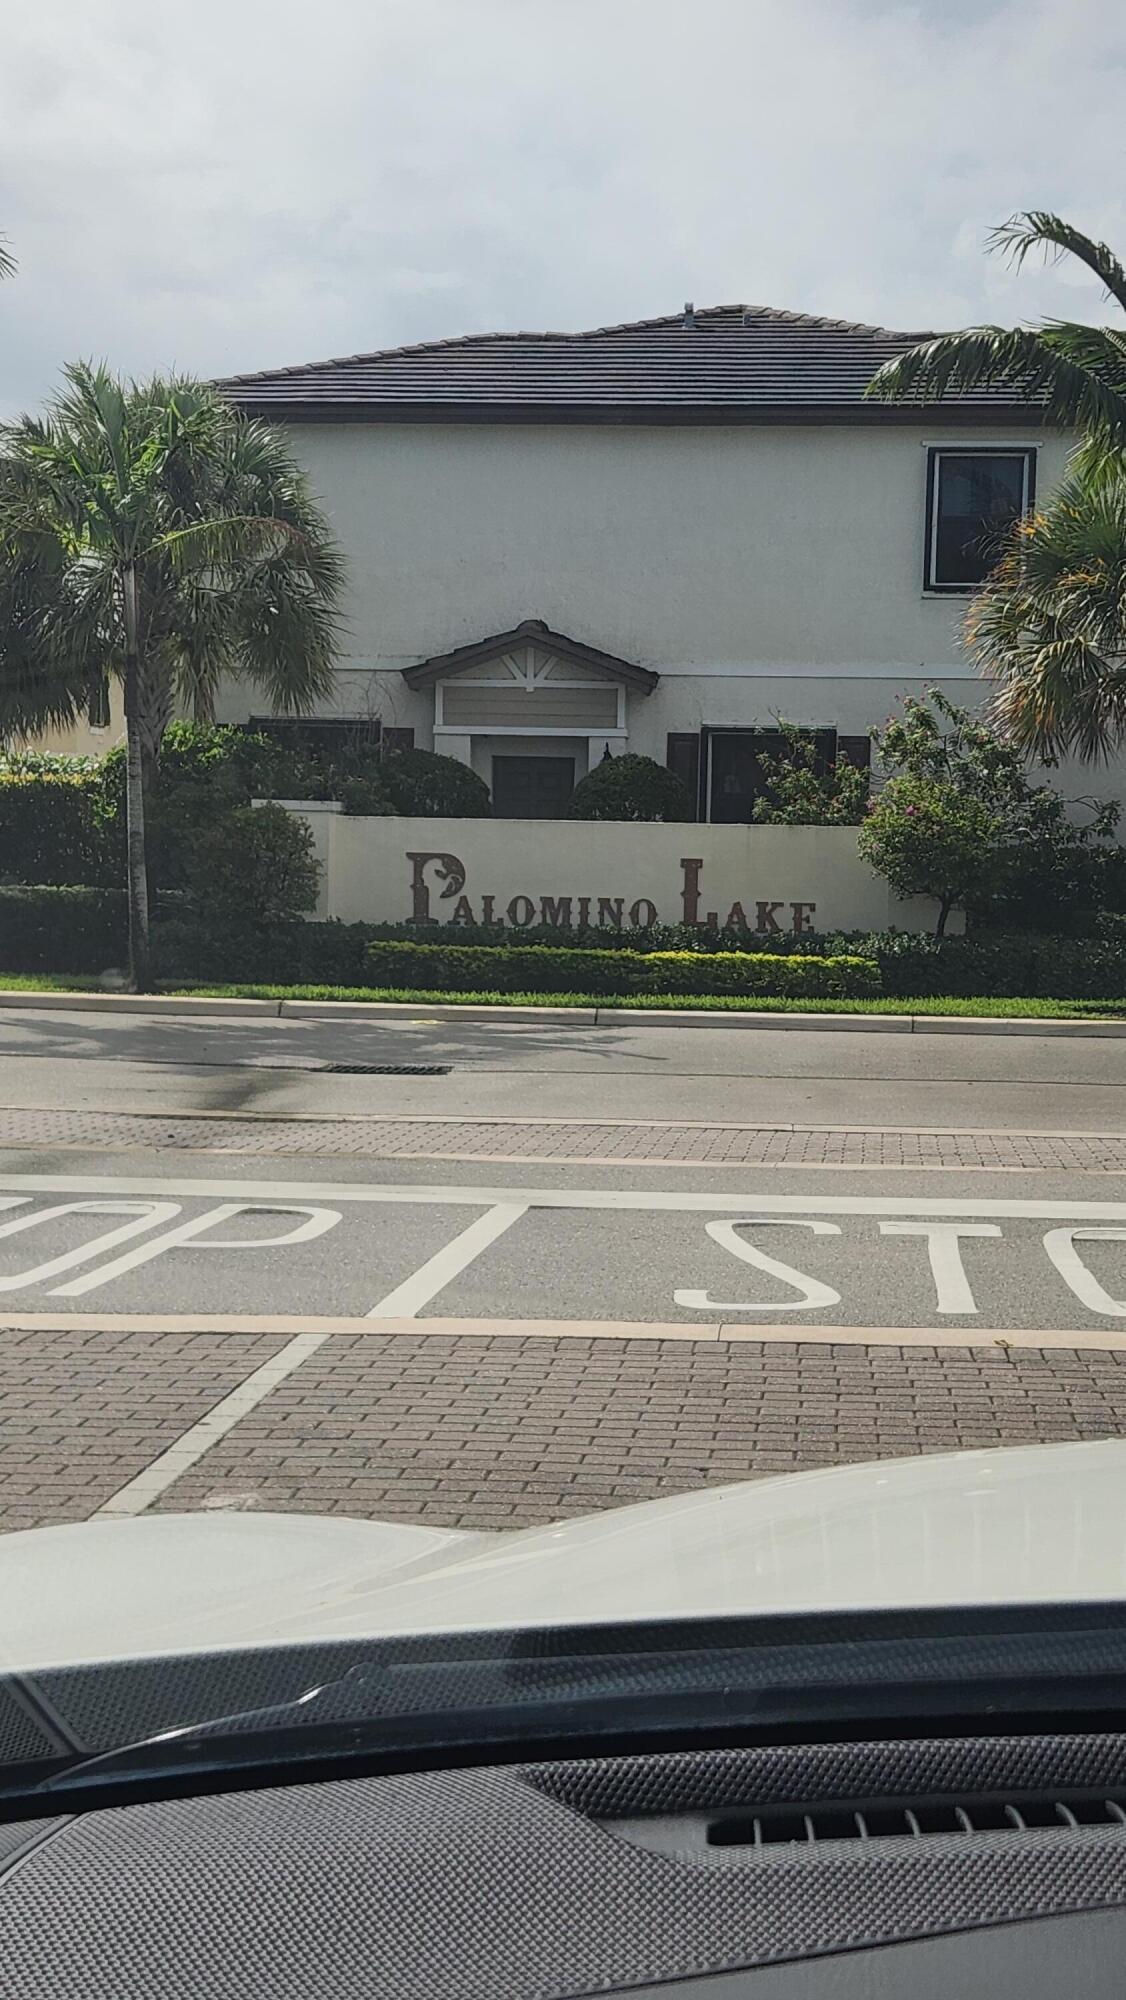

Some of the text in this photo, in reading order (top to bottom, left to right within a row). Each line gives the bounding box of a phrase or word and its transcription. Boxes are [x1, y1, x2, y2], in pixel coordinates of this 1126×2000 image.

[405, 851, 817, 933] PALOMINO LAKE
[0, 1197, 343, 1297] OP
